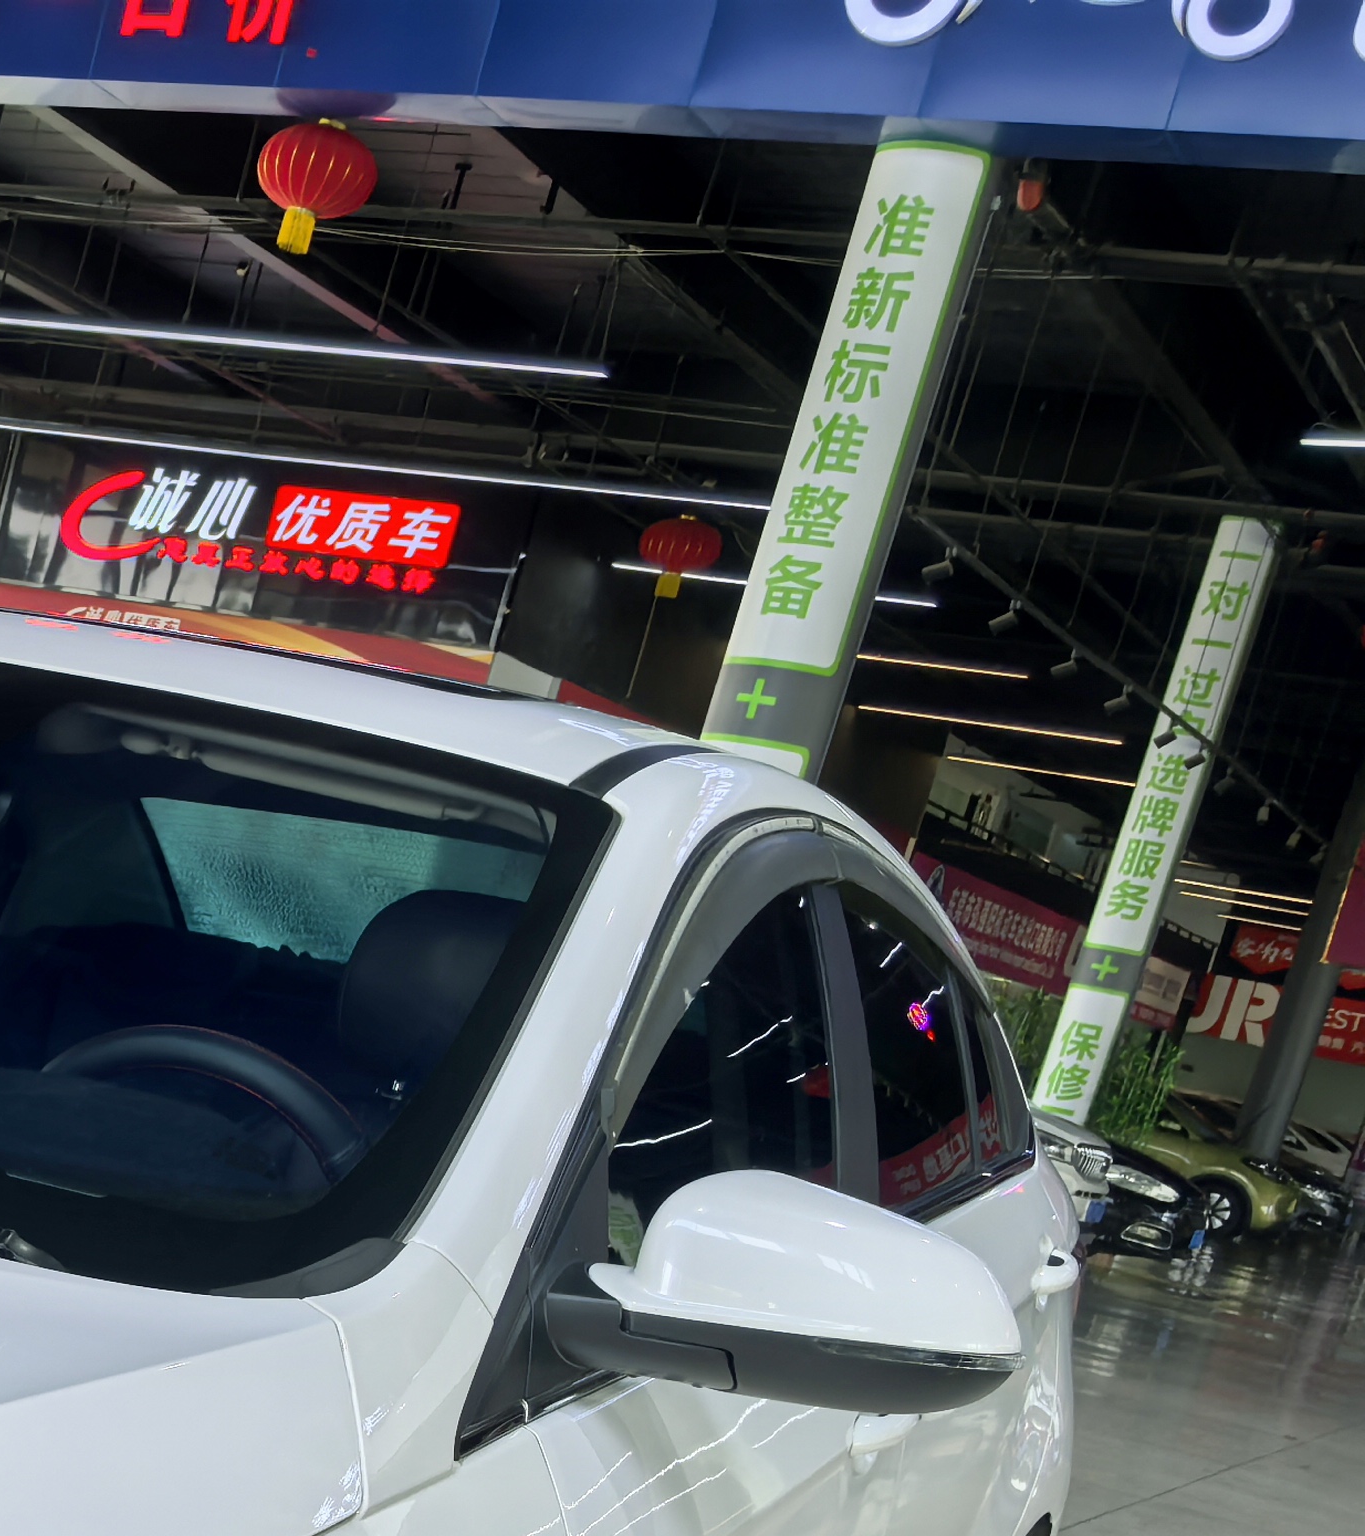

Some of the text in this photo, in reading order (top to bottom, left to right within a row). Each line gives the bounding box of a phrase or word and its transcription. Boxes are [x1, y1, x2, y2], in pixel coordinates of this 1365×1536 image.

[760, 193, 935, 620] 准新标准整备
[127, 466, 452, 559] 诚心 优质车
[156, 535, 436, 595] 您真正放心的选择
[1185, 974, 1281, 1048] JR
[1040, 1019, 1104, 1117] 保修
